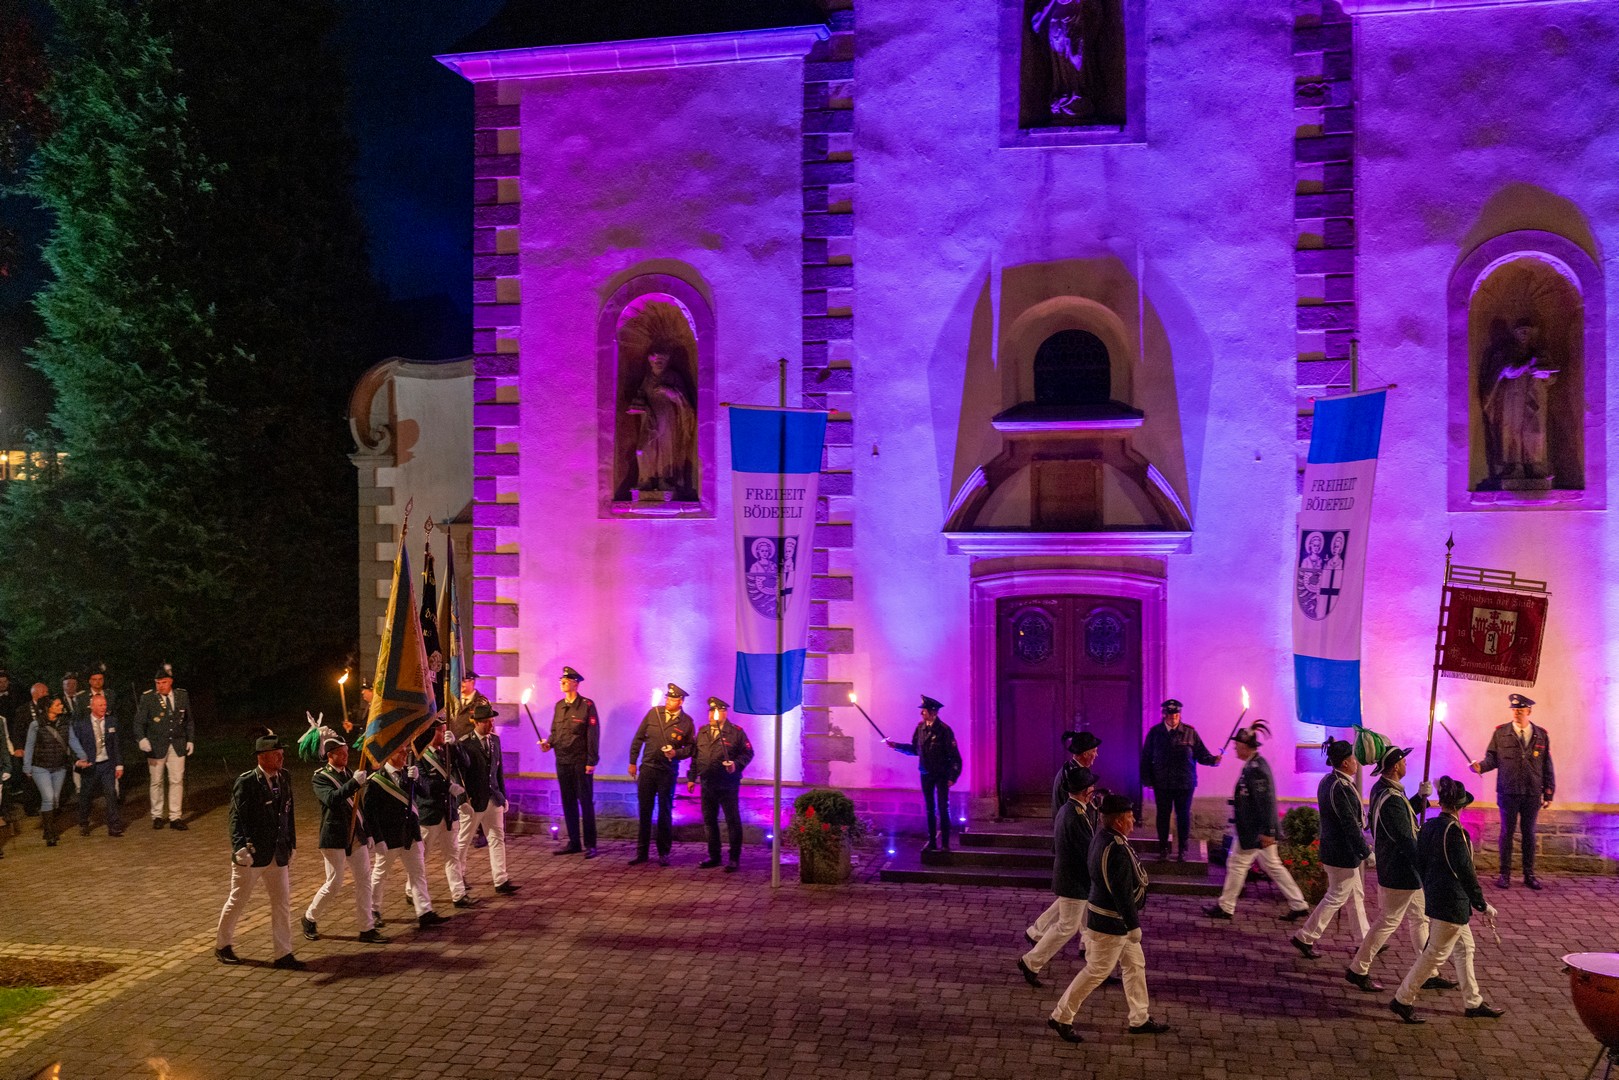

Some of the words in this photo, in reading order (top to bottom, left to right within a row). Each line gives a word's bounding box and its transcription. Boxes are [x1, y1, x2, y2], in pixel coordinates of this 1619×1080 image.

[1311, 477, 1357, 492] FREIHEIT
[745, 488, 806, 500] FREIHEIT
[1305, 496, 1355, 511] BÖDEFELD
